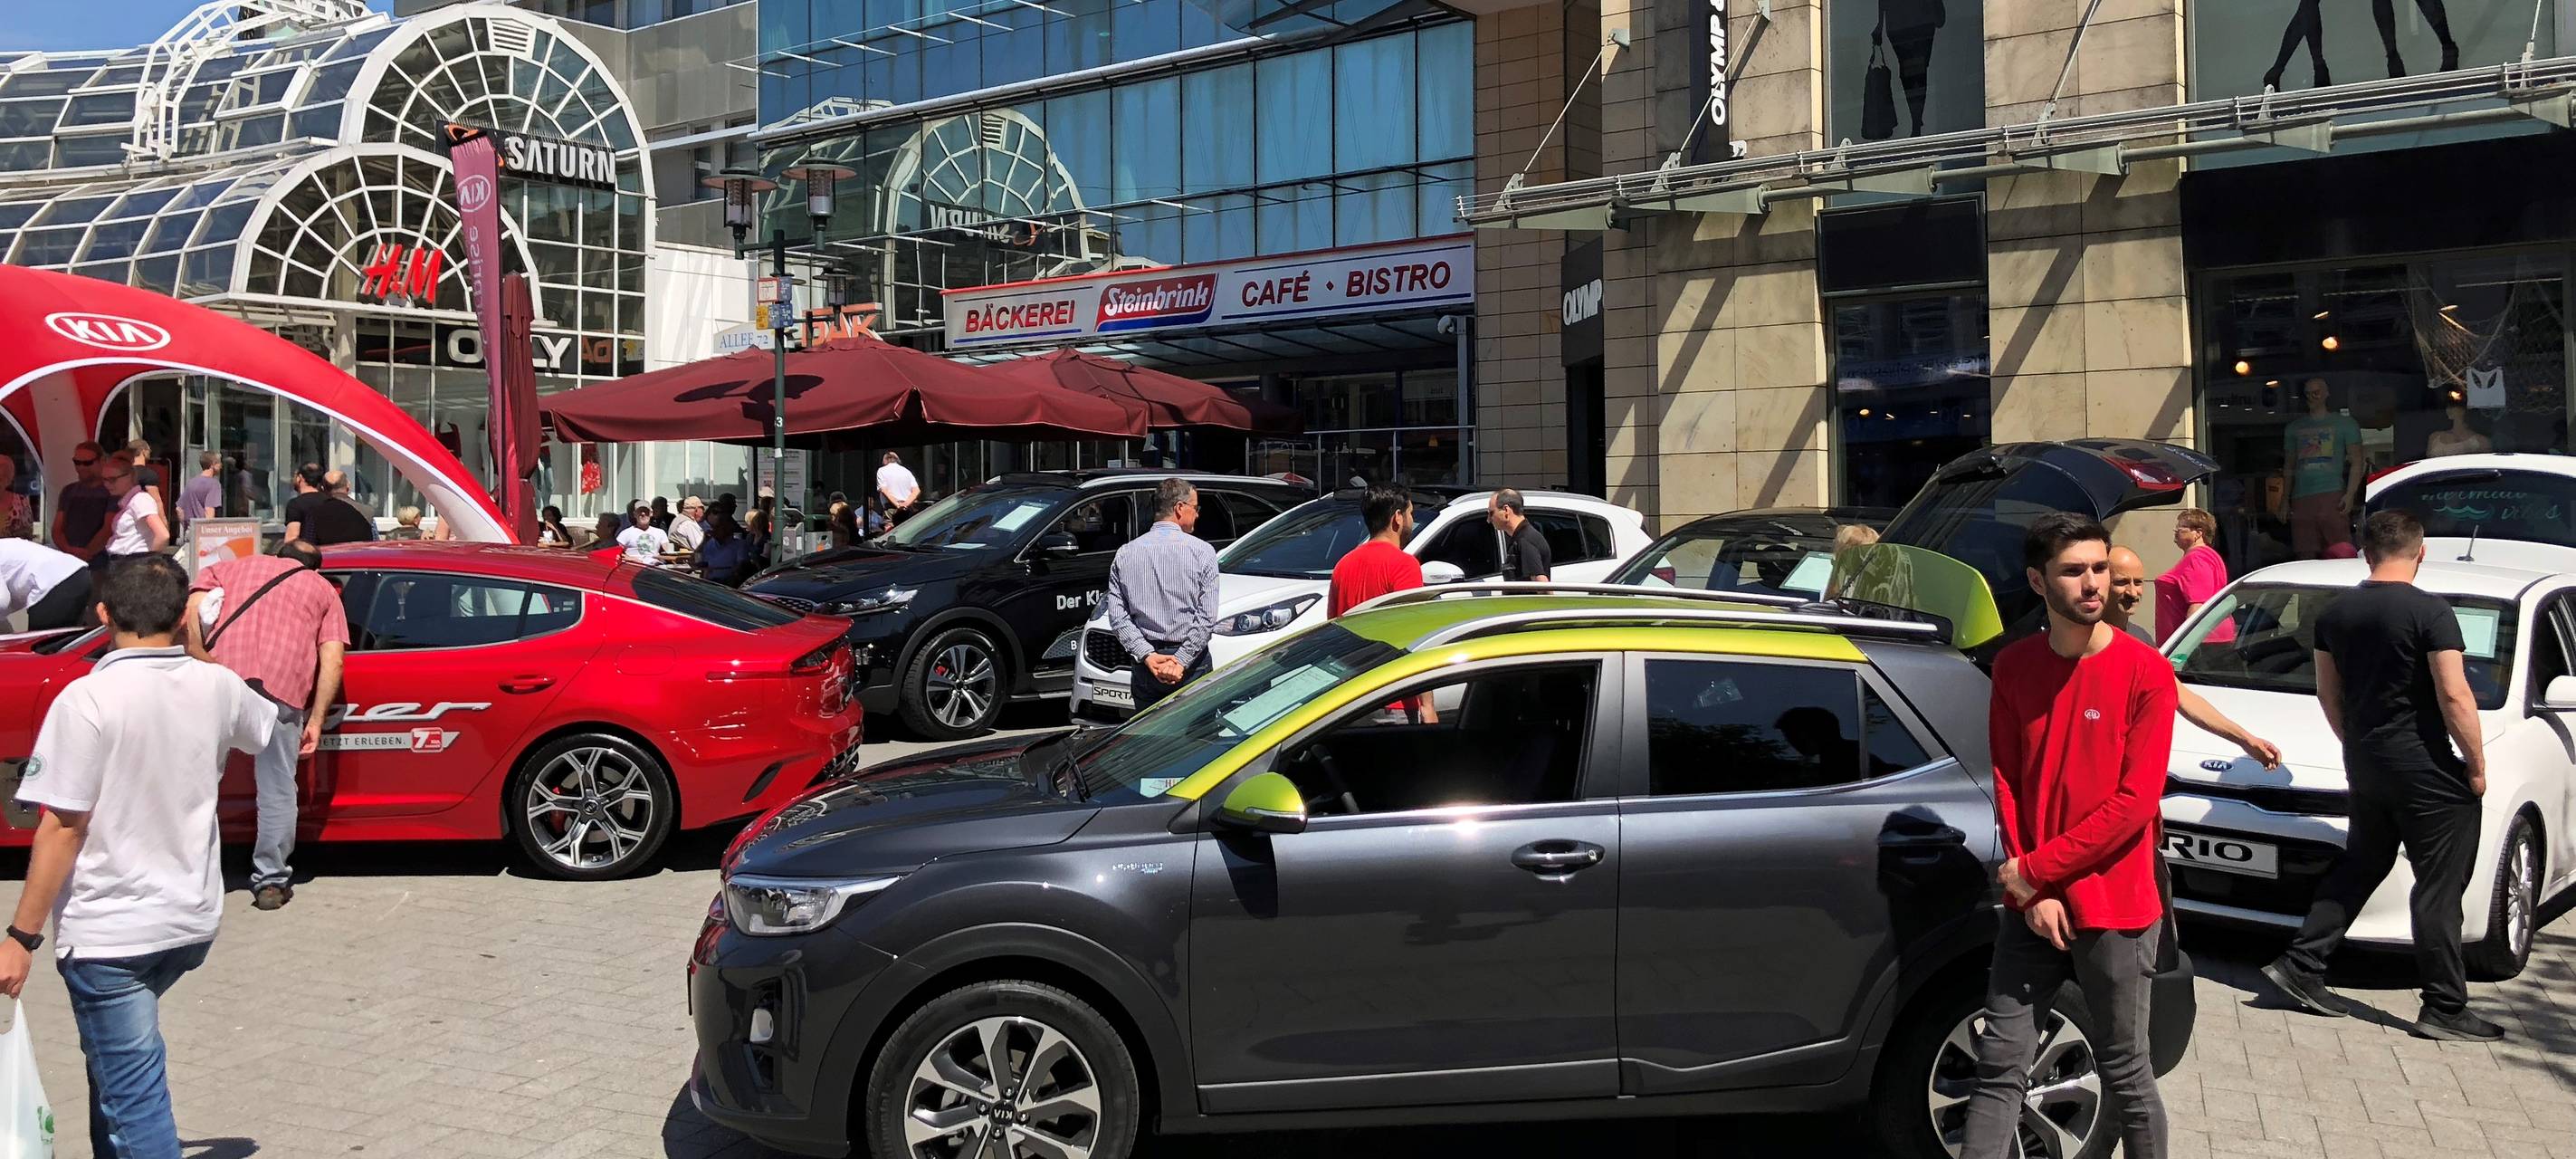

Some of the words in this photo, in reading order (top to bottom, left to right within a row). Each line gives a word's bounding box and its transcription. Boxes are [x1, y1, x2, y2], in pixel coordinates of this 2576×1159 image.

[1710, 14, 1726, 126] OLYMP
[505, 135, 616, 184] SATURN
[364, 243, 442, 303] H&M
[1241, 270, 1311, 308] CAFÉ
[1345, 261, 1451, 298] BISTRO
[1104, 281, 1209, 316] Steinbrink
[1562, 278, 1603, 326] OLYMP
[60, 317, 157, 343] KIA
[965, 300, 1075, 333] BÄCKEREI
[757, 334, 768, 346] 72
[1056, 595, 1082, 610] Der
[1086, 589, 1103, 606] Kl
[354, 735, 406, 746] ERLEBEN.
[2203, 760, 2228, 771] KIA
[2163, 832, 2253, 863] RIO
[994, 1108, 1013, 1120] KIA
